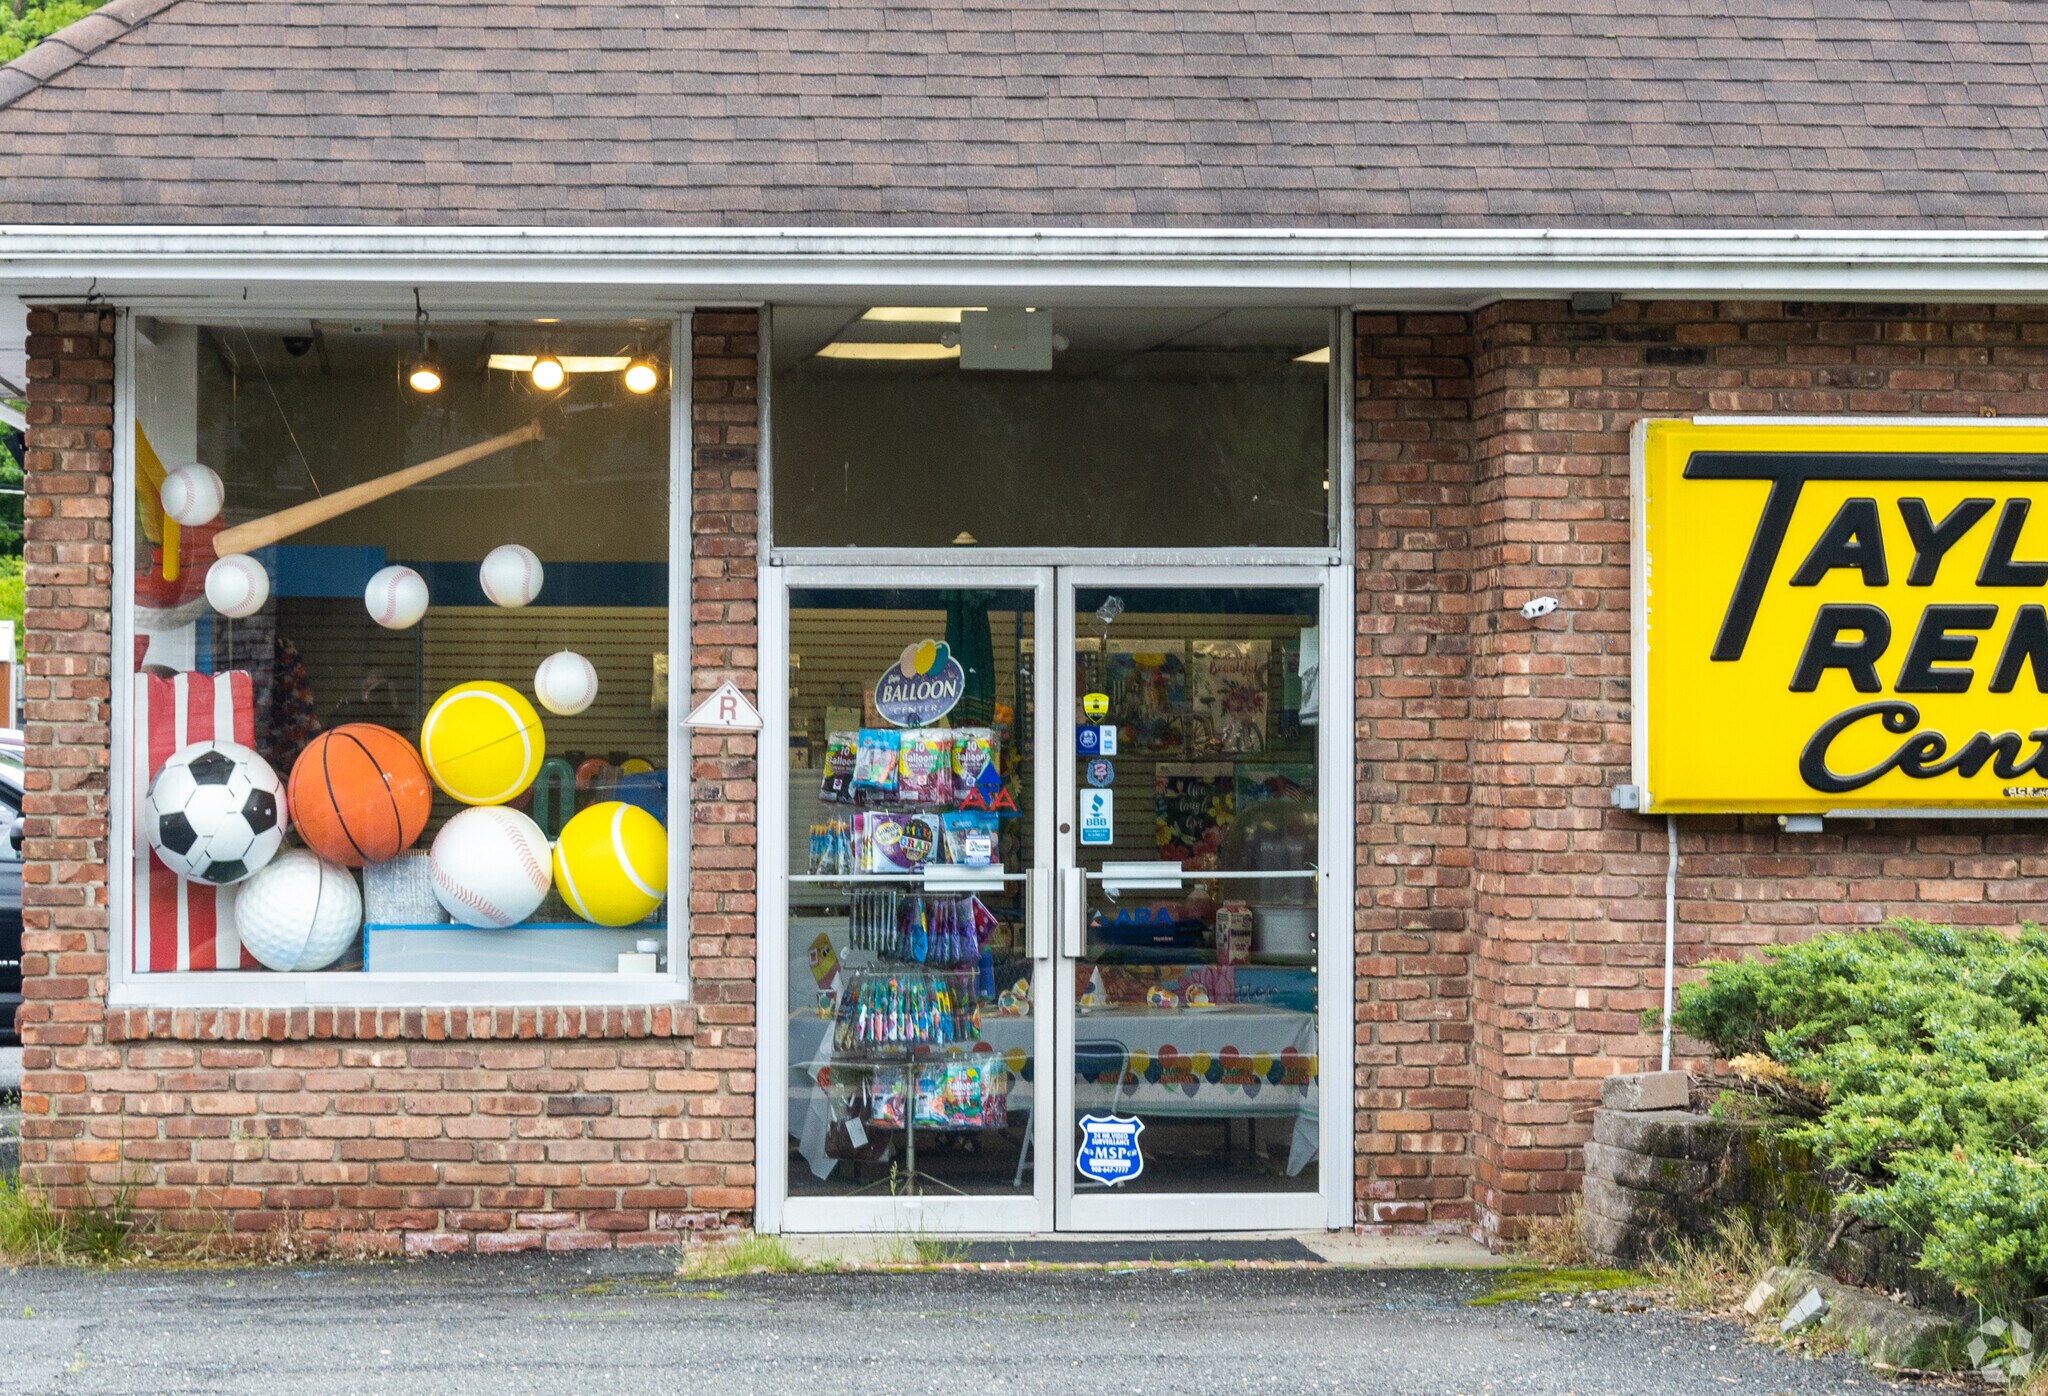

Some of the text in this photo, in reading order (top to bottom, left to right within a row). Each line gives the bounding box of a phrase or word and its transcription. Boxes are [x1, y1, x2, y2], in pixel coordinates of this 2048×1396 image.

[1682, 450, 2048, 662] TAYL
[882, 680, 957, 703] BALLOON
[719, 696, 737, 720] R
[893, 704, 938, 715] CENTER
[840, 747, 850, 756] 10
[915, 743, 925, 752] 10
[967, 741, 978, 751] 10
[1086, 818, 1107, 826] BBB
[900, 836, 932, 853] GRAD
[1113, 907, 1173, 926] ARA
[1111, 1132, 1129, 1140] VIDEO
[1091, 1138, 1130, 1146] SURVEILLANCE
[1095, 1146, 1127, 1159] MSP
